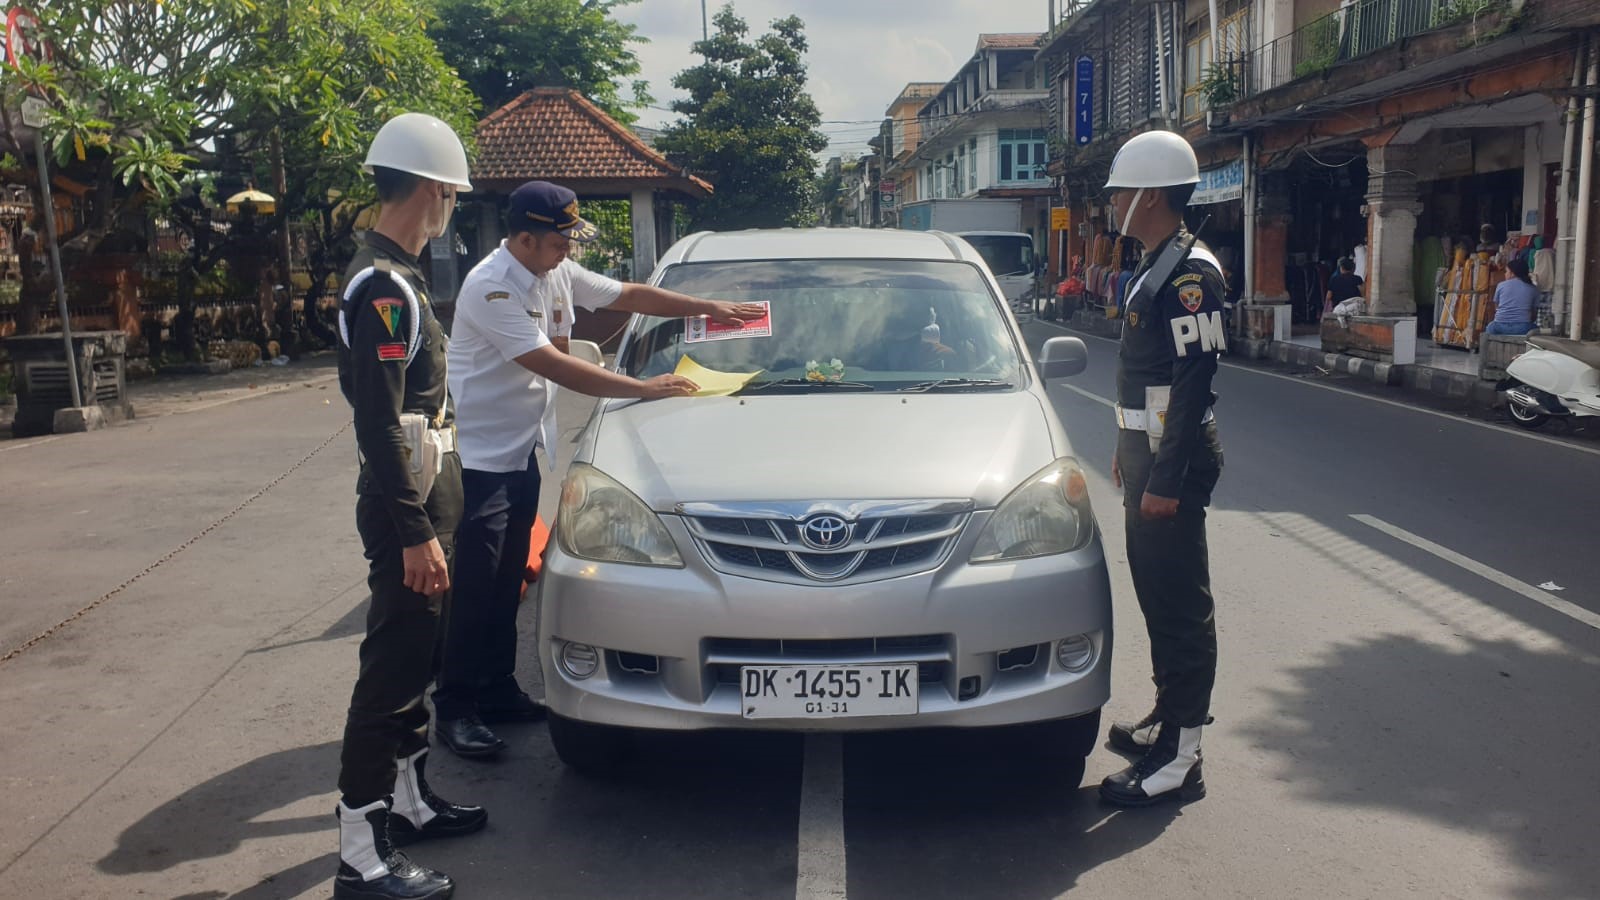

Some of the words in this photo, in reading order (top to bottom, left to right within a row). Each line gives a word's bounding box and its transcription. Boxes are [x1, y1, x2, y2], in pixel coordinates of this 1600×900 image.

[1170, 311, 1226, 357] PM
[745, 669, 777, 697] DK
[794, 669, 861, 698] 1455
[878, 669, 911, 697] IK
